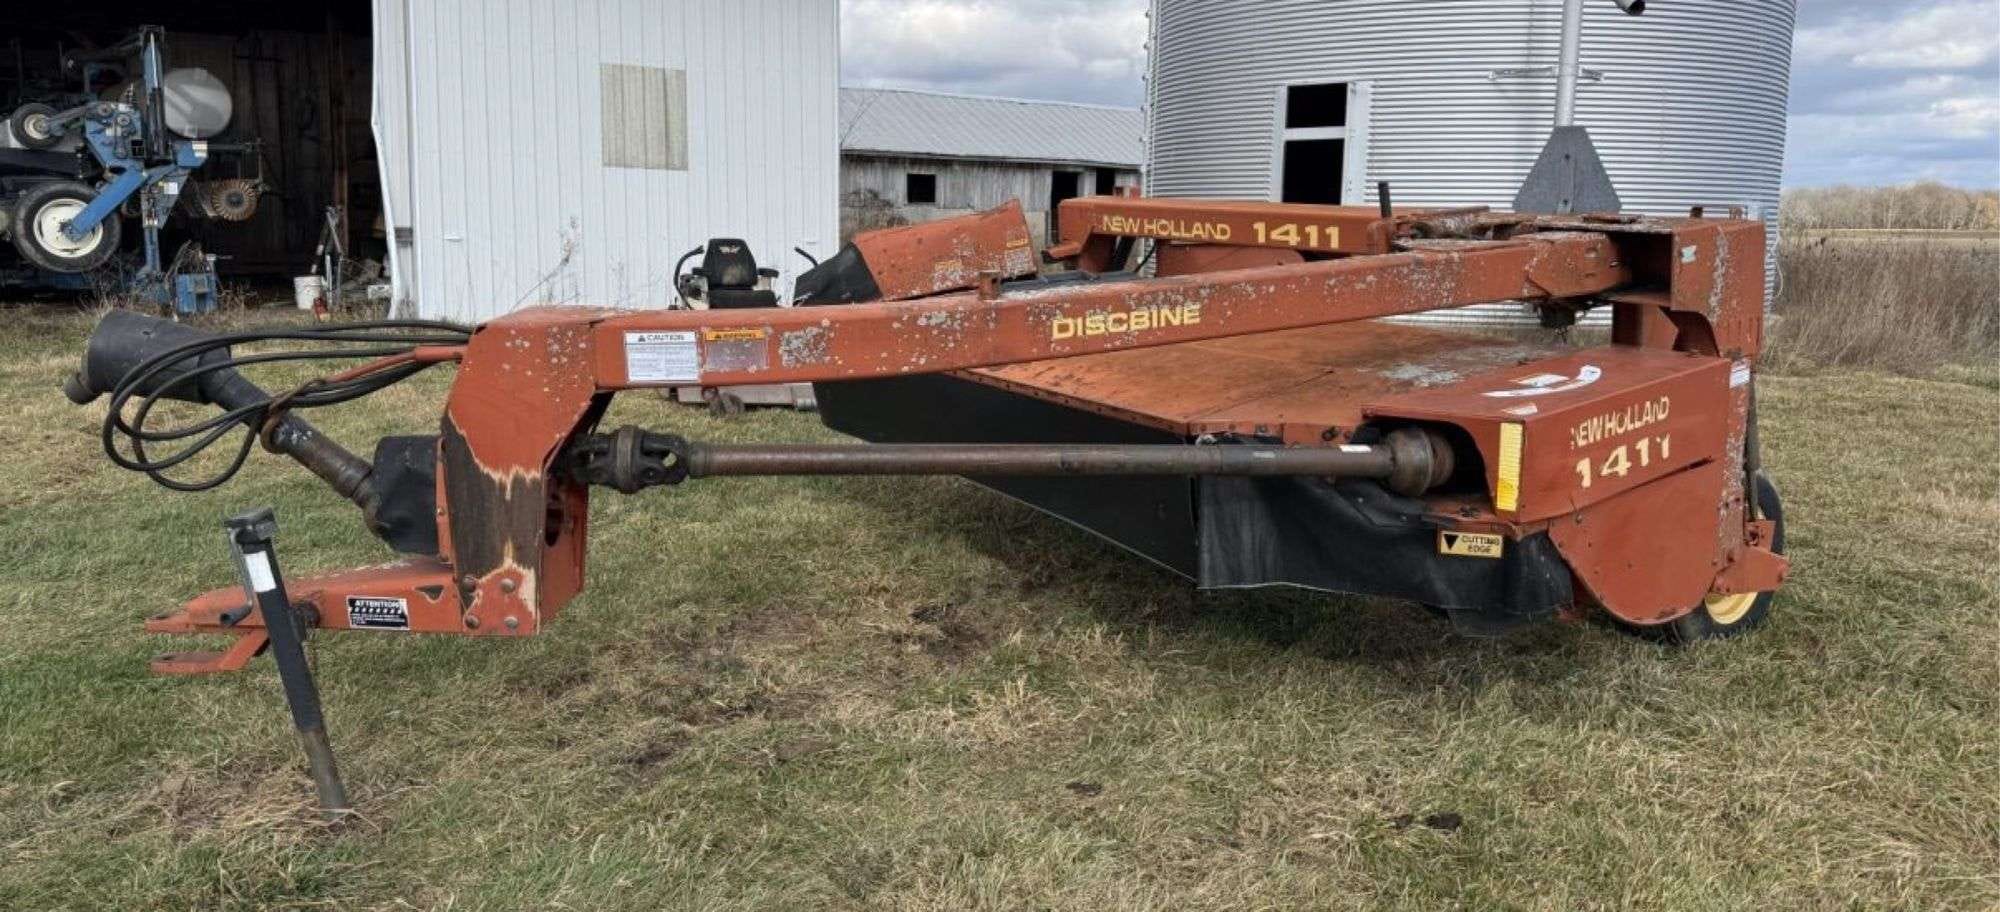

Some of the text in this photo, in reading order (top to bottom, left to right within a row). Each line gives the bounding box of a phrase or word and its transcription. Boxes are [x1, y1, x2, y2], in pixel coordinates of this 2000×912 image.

[1102, 215, 1340, 249] NEW HOLLAND 1411
[1052, 303, 1201, 340] DISCBINE
[1604, 396, 1670, 439] HOLLAND
[1576, 433, 1671, 488] 1411
